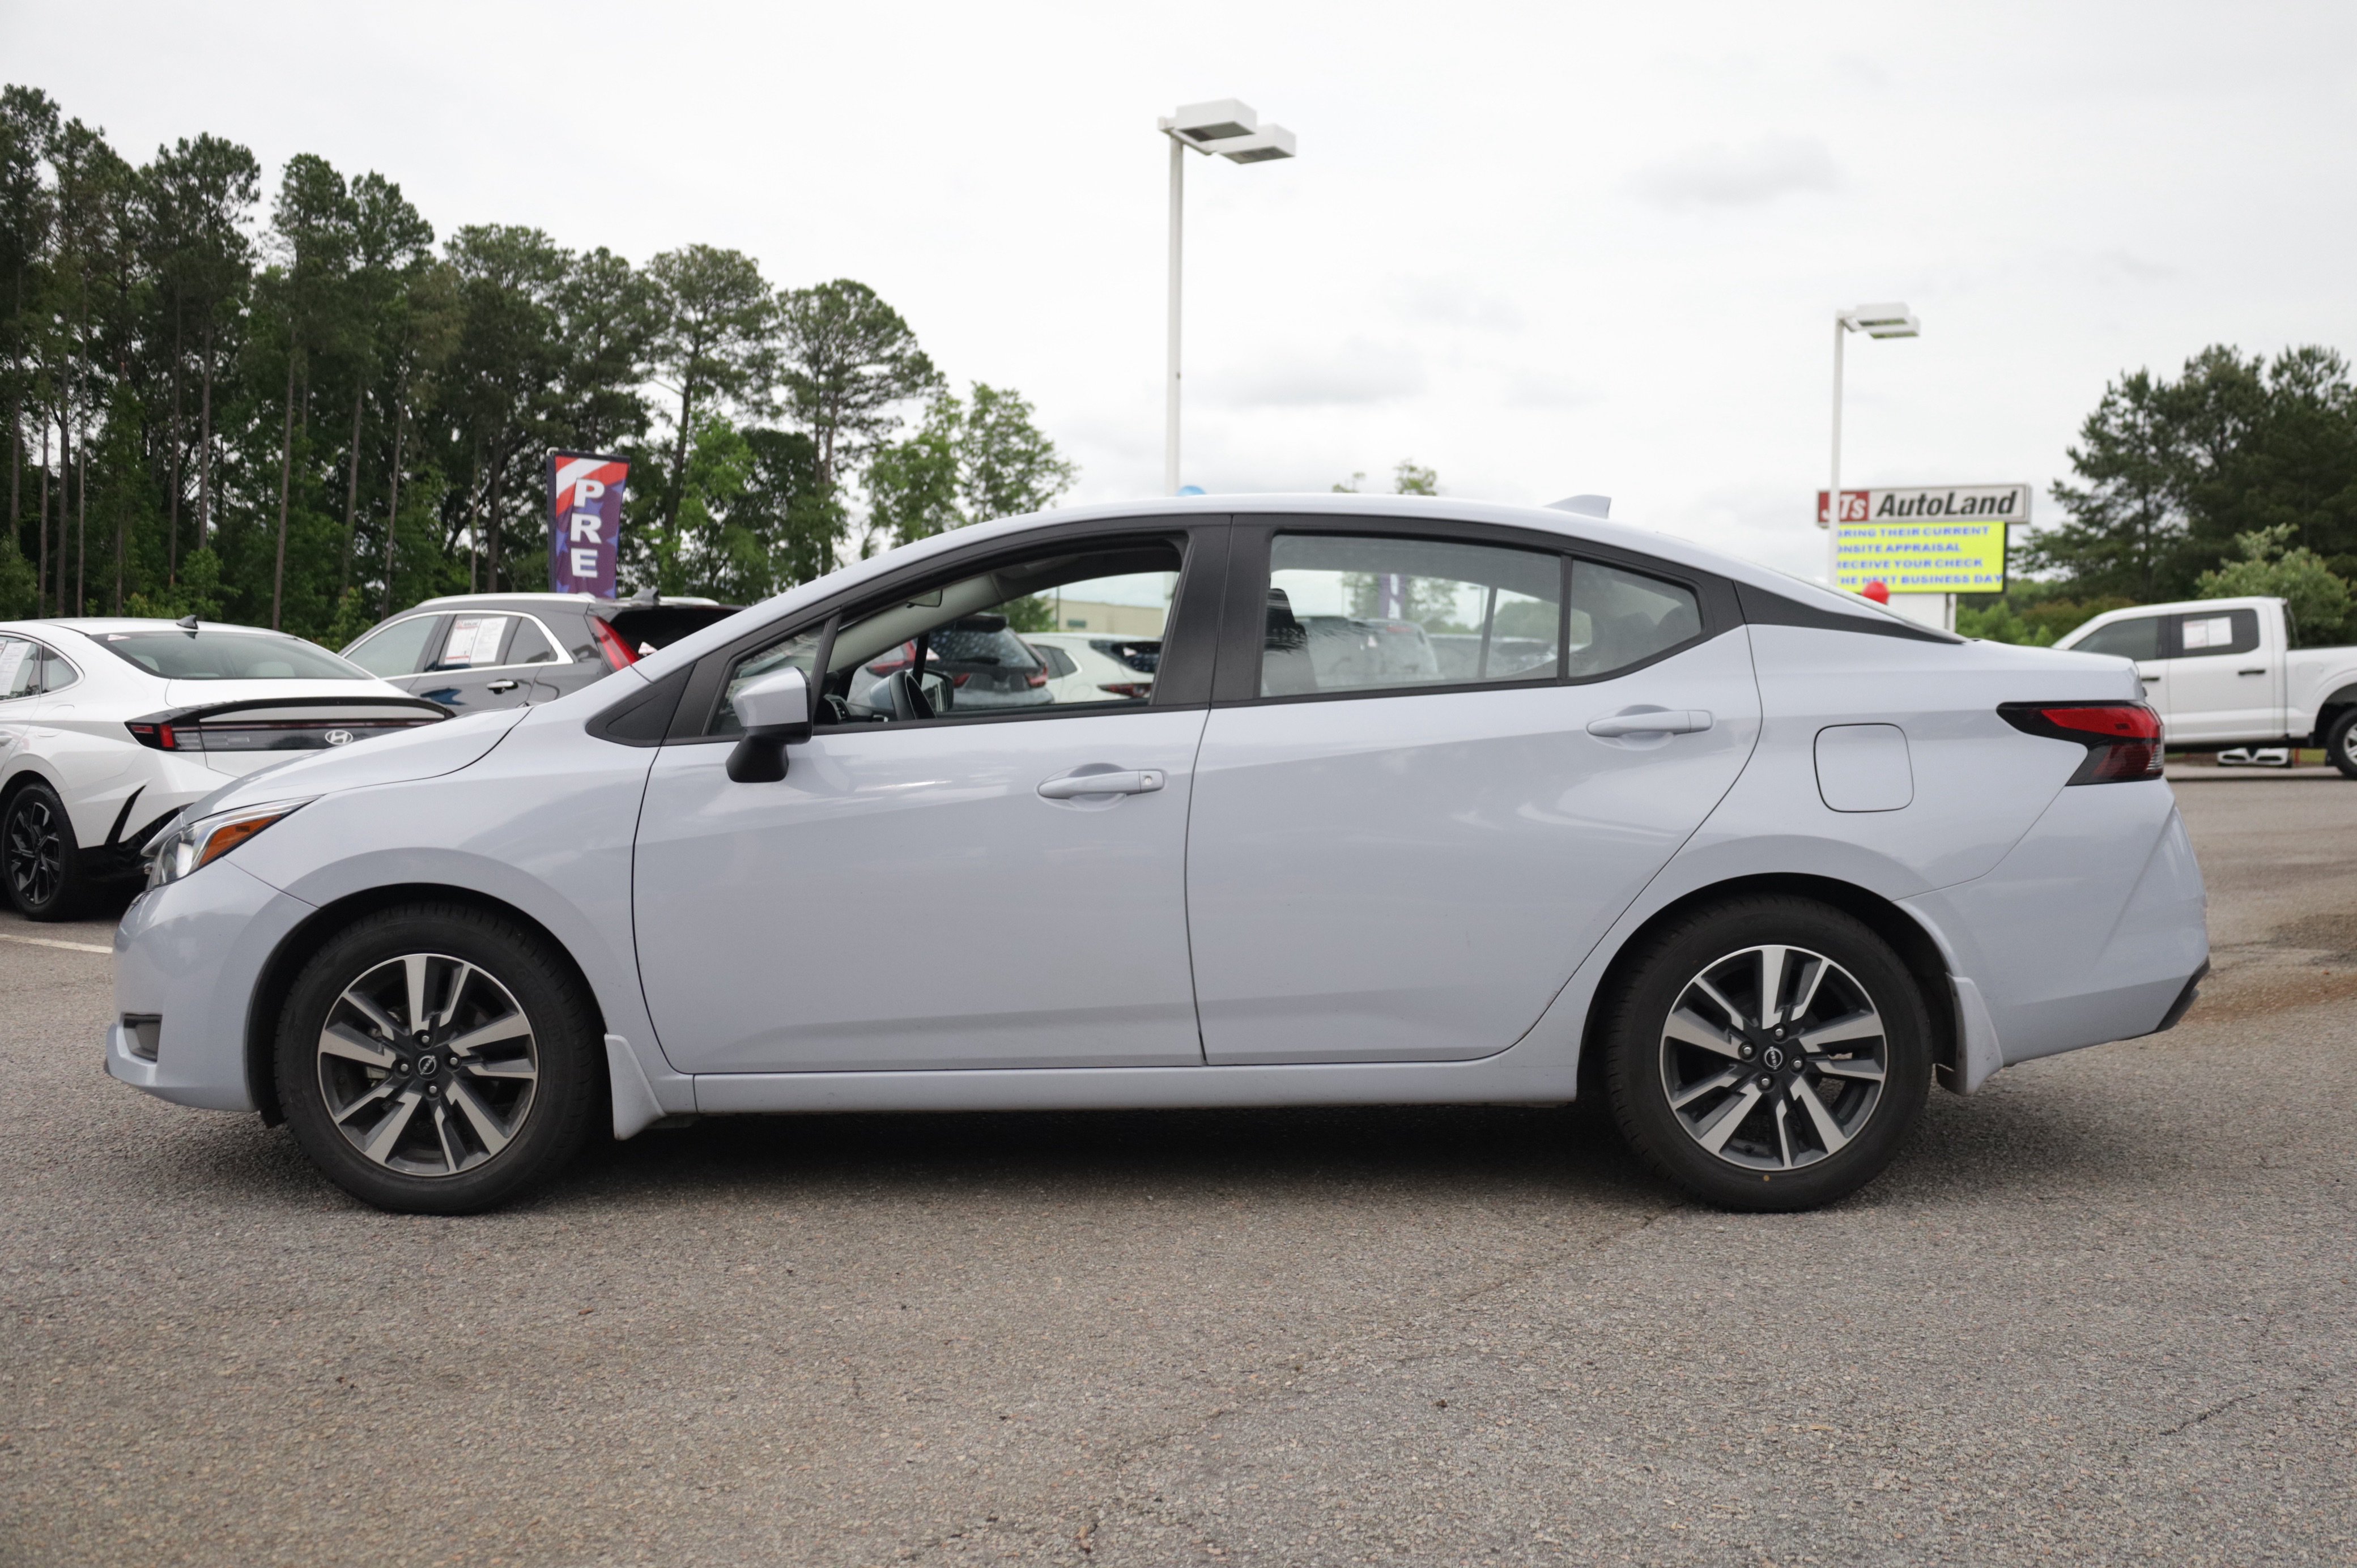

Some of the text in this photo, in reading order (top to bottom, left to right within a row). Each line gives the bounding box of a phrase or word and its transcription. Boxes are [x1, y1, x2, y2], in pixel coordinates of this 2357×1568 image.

[1876, 491, 2018, 517] AutoLand
[570, 478, 605, 578] PRE
[1880, 527, 1920, 536] THEIR
[1923, 526, 1990, 536] CURRENT
[1886, 543, 1961, 553] APPRAISAL
[1894, 559, 1932, 568] YOUR
[1935, 558, 1983, 568] CHECK
[1839, 576, 1858, 585] HE
[1901, 574, 1970, 584] BUSINESS
[1974, 574, 2003, 583] DAY
